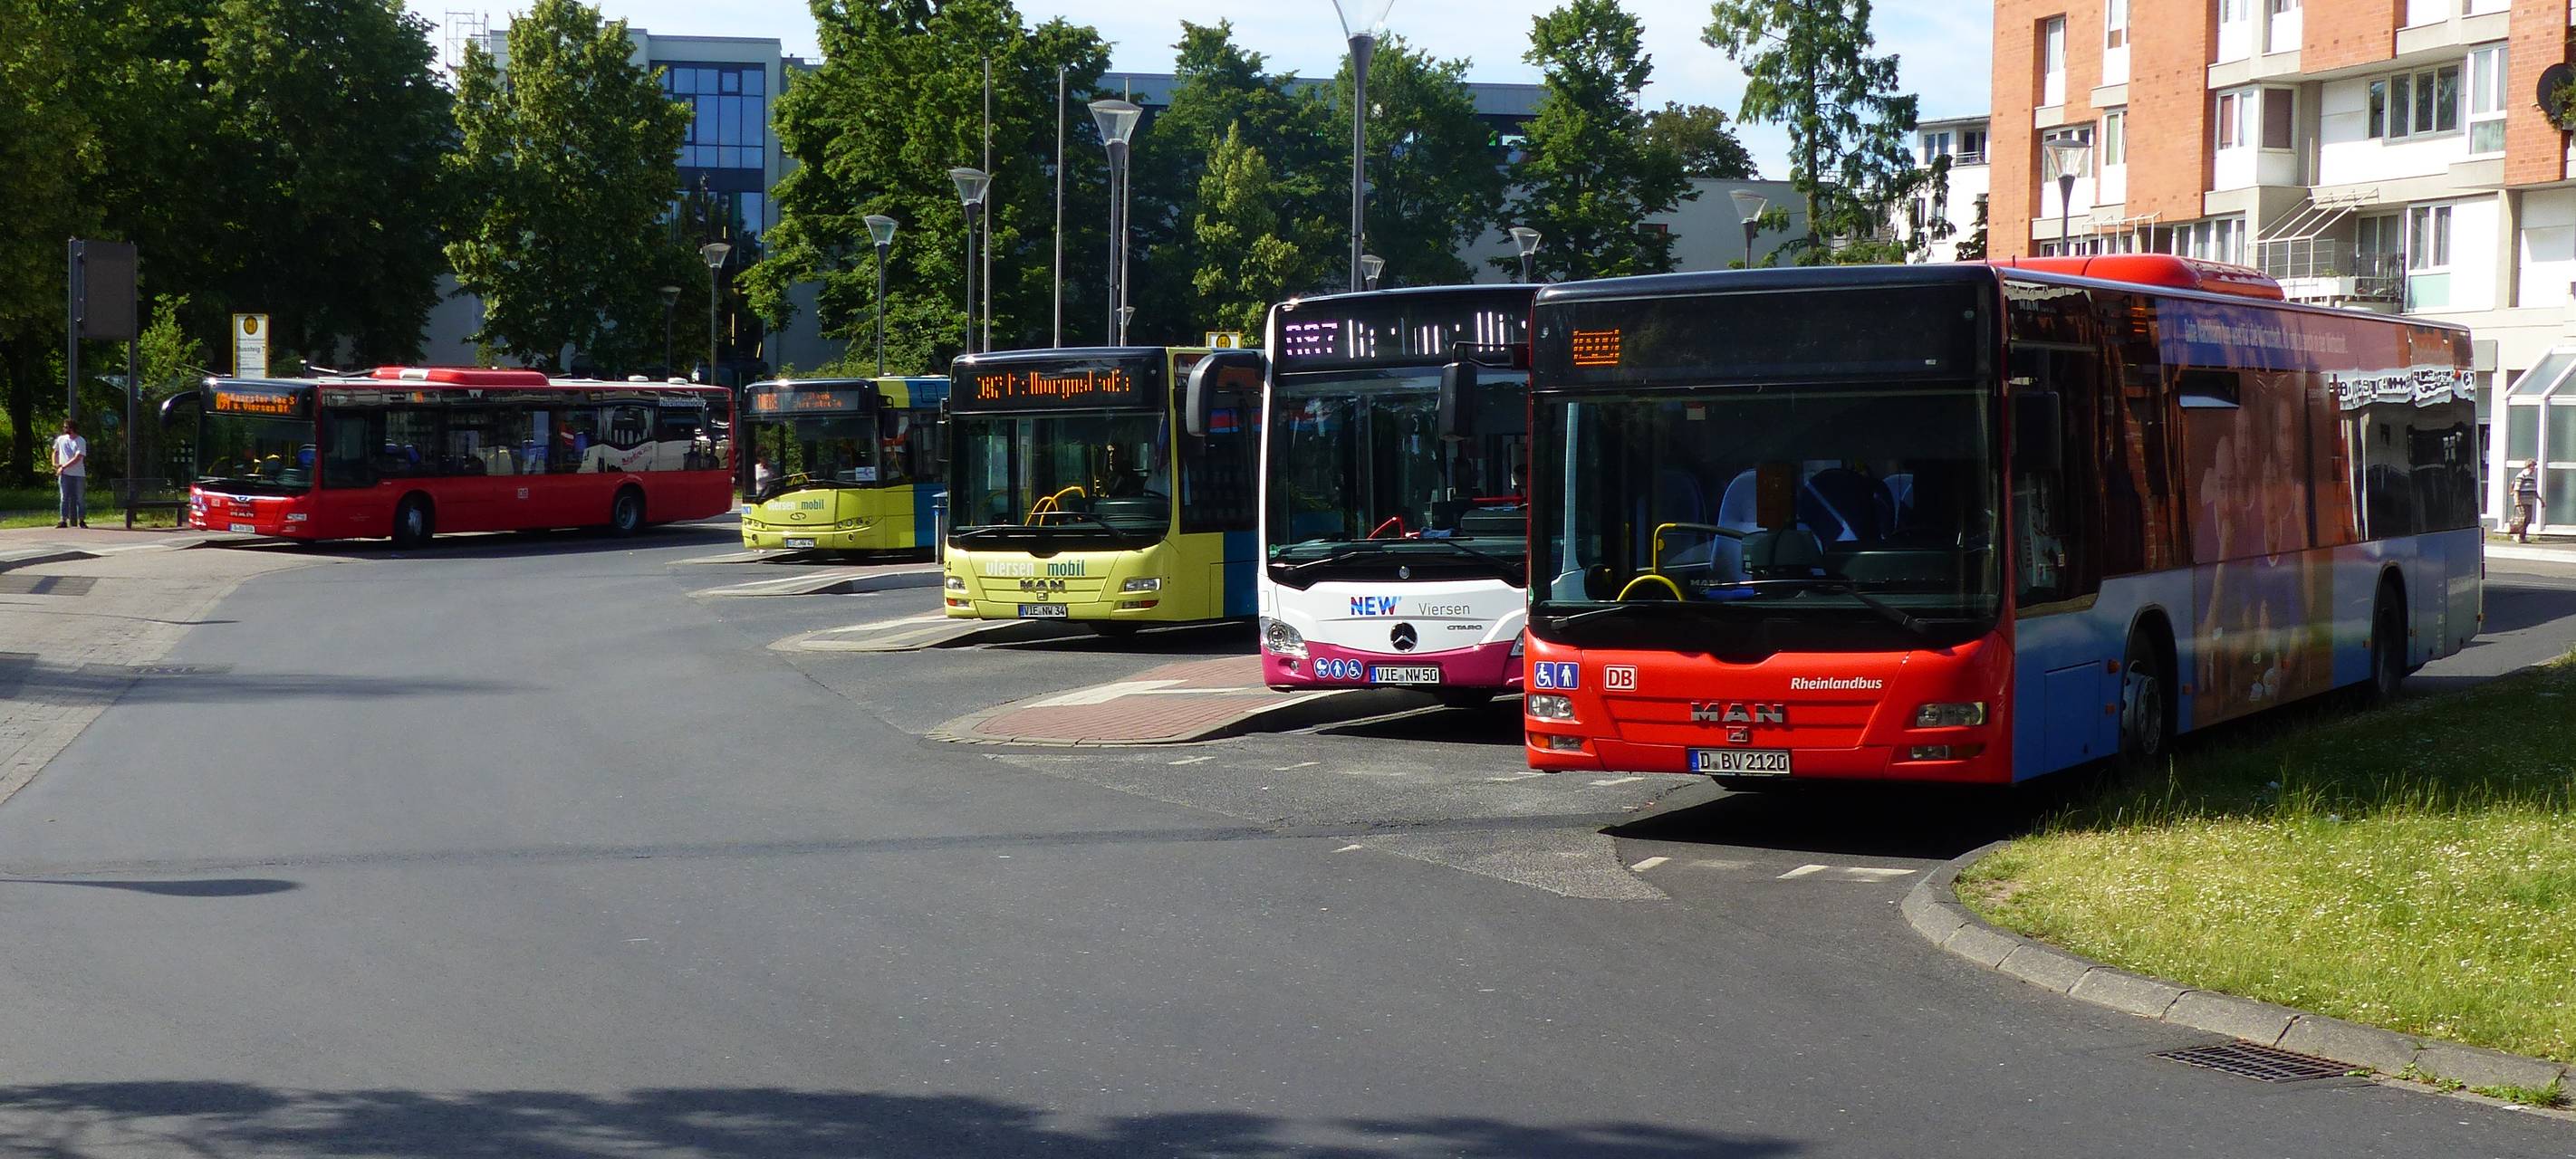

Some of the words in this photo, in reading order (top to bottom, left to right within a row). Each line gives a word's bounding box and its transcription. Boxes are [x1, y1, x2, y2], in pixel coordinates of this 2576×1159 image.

[659, 397, 706, 407] Rheinlandbus
[802, 499, 824, 510] mobil
[985, 560, 1034, 577] viersen
[1047, 559, 1086, 577] mobil
[1020, 580, 1065, 593] MAN
[1024, 605, 1039, 616] VIE
[1043, 605, 1053, 616] NW
[1054, 605, 1065, 616] 34
[1350, 596, 1399, 616] NEW
[1418, 602, 1471, 616] Viersen
[1377, 668, 1399, 681] VIE
[1405, 668, 1421, 681] NW
[1422, 668, 1437, 681] 50
[1608, 668, 1632, 688] DB
[1791, 676, 1883, 690] Rheinlandbus
[1690, 702, 1784, 723] MAN
[1698, 754, 1710, 770] D
[1720, 754, 1743, 771] BV
[1745, 754, 1787, 771] 2120
